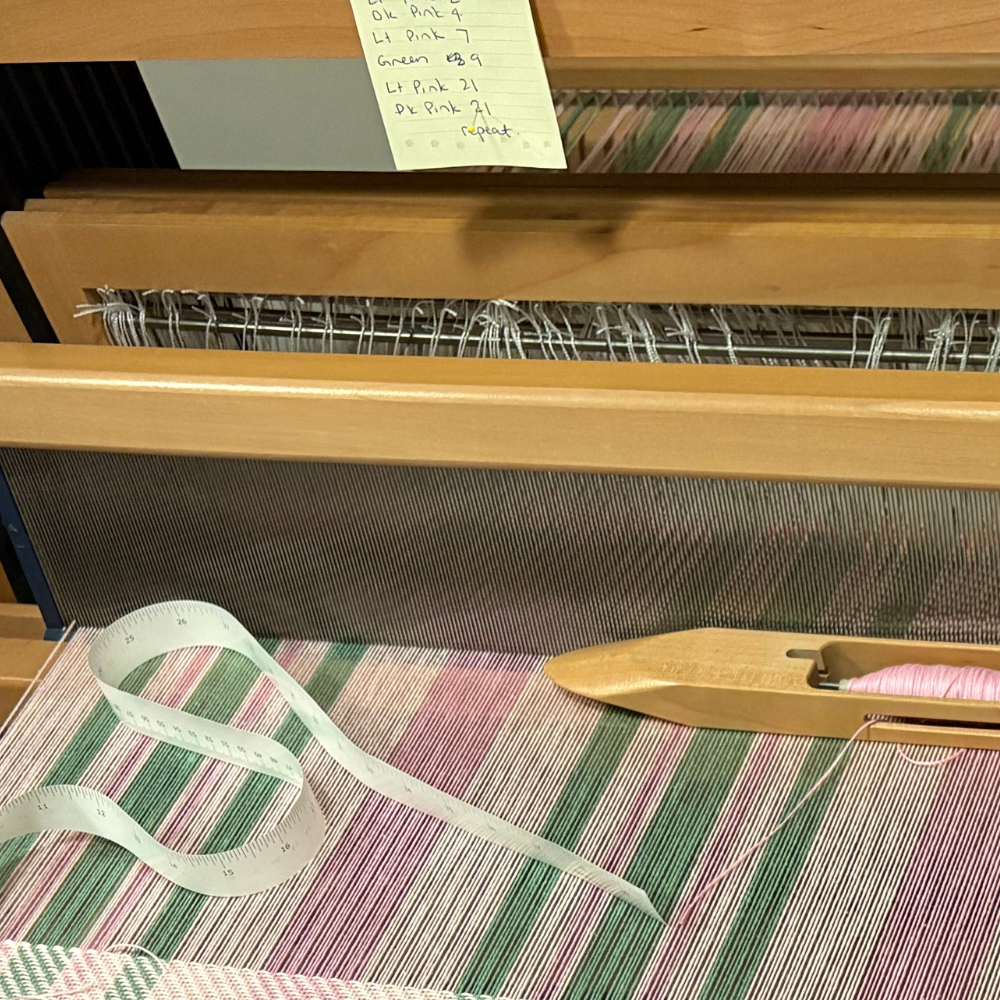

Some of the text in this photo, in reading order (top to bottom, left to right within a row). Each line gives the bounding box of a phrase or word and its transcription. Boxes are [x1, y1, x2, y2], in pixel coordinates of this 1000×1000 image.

[410, 4, 445, 18] Pink
[372, 27, 469, 44] Lt Pink 7
[377, 55, 429, 67] Green
[385, 78, 479, 94] Lt Pink 21
[423, 100, 461, 115] Pink
[470, 99, 491, 116] 21
[125, 618, 188, 645] 25 26
[37, 803, 49, 811] 11
[97, 809, 106, 818] 12
[222, 869, 235, 877] 15
[281, 842, 291, 853] 16
